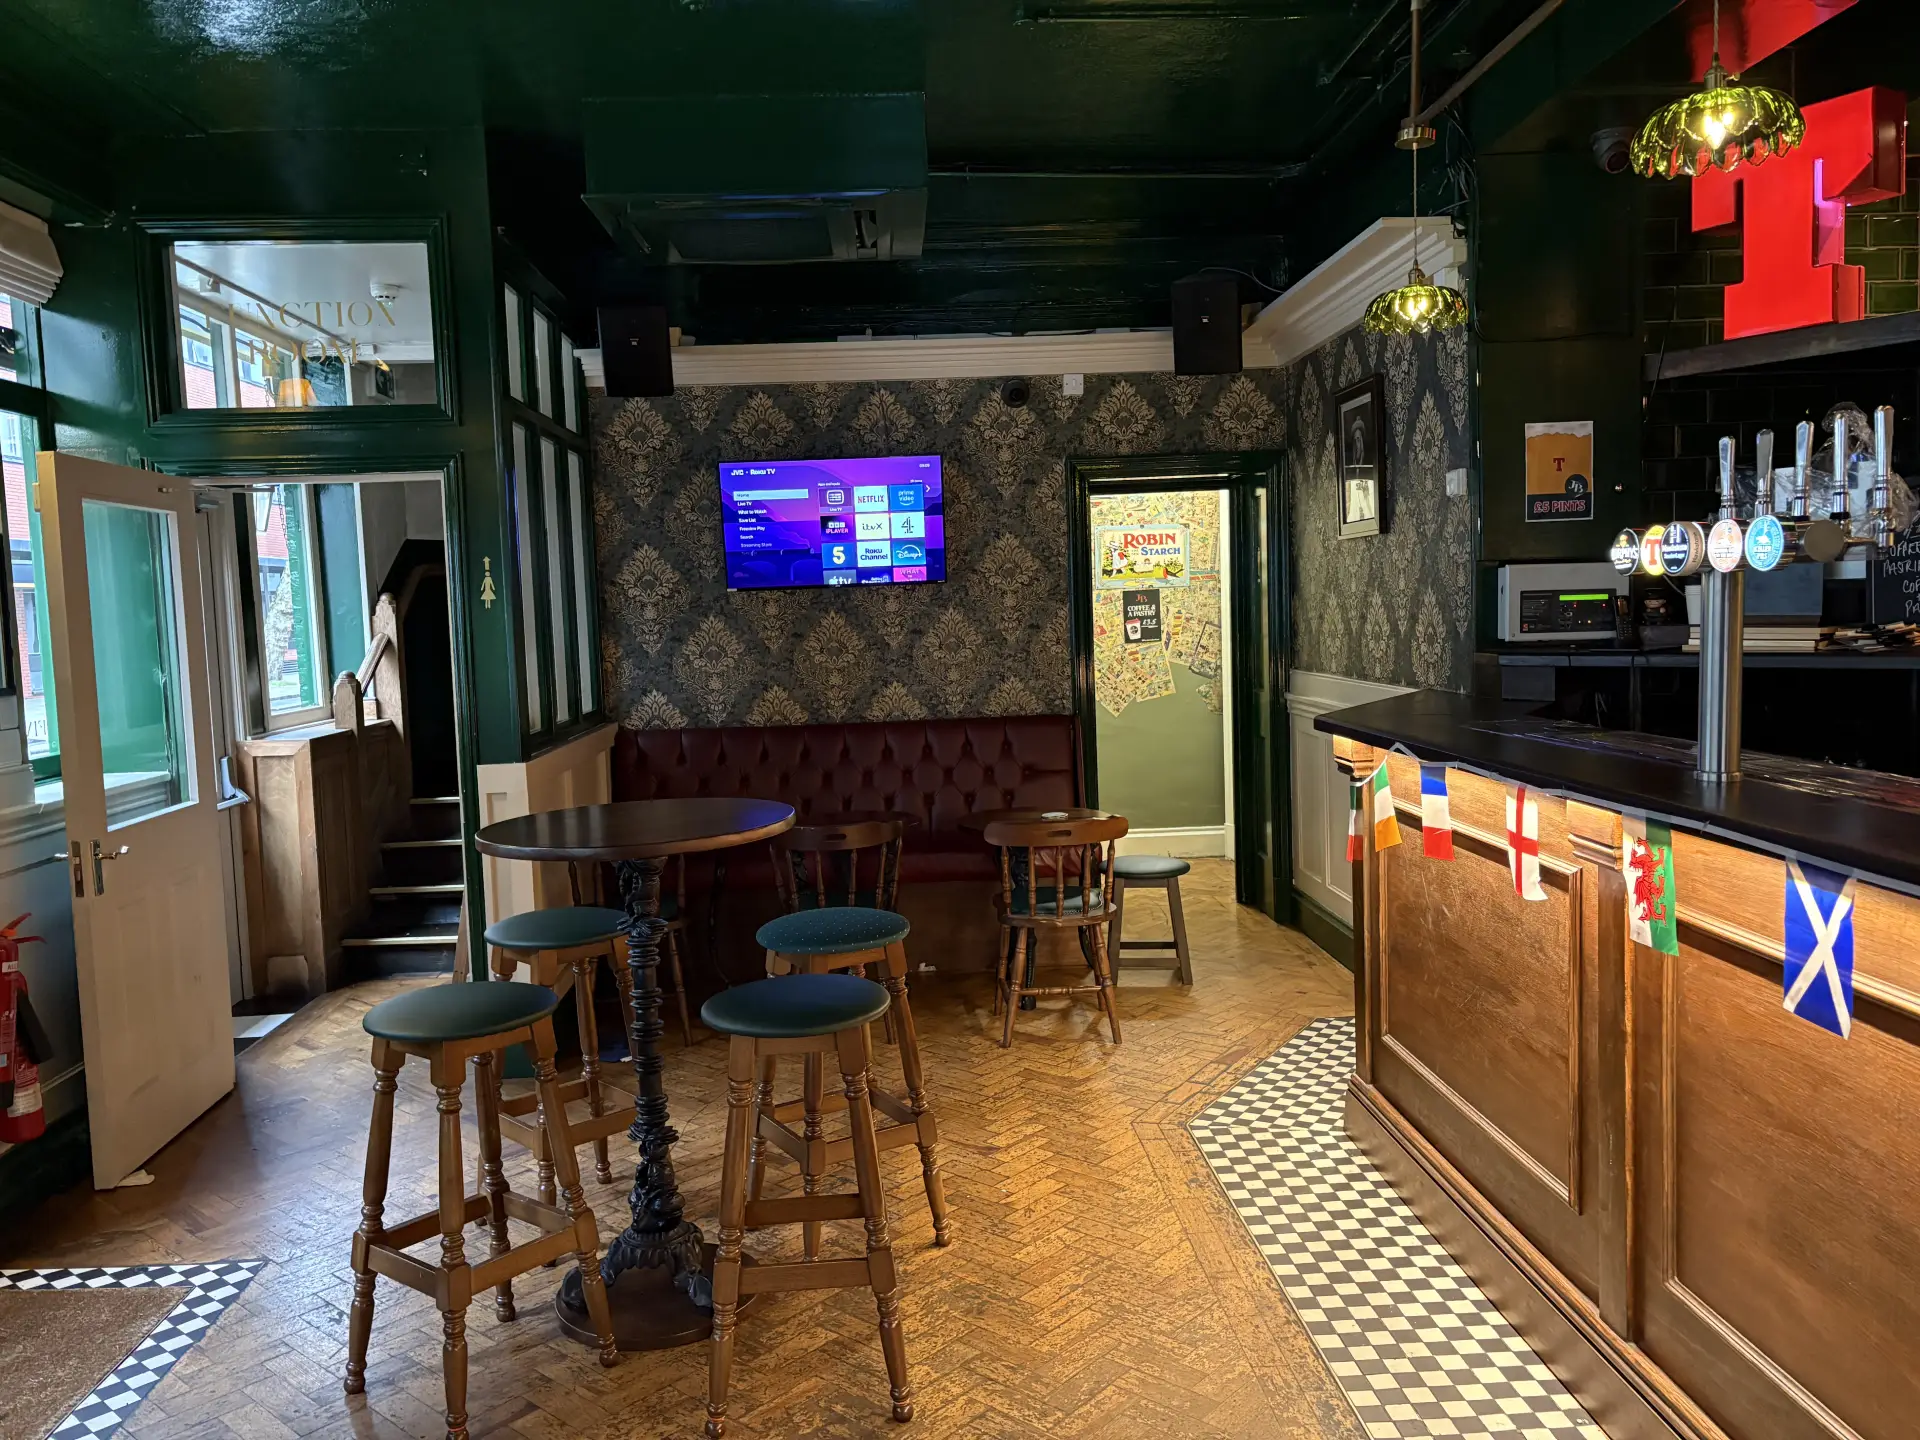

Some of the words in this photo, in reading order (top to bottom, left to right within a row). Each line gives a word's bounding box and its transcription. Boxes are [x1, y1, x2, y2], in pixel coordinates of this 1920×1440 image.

[1692, 85, 1906, 341] T
[1552, 457, 1565, 472] T
[857, 494, 884, 503] NETFLIX
[1533, 501, 1550, 514] £5
[1551, 499, 1586, 513] PINTS
[901, 516, 914, 534] 4
[1123, 533, 1176, 549] ROBIN
[832, 546, 846, 564] 5
[860, 553, 888, 561] Channel
[1140, 546, 1181, 556] STARCH
[1645, 539, 1661, 566] T
[1127, 604, 1150, 612] COFFEE
[1133, 609, 1156, 617] PASTRY
